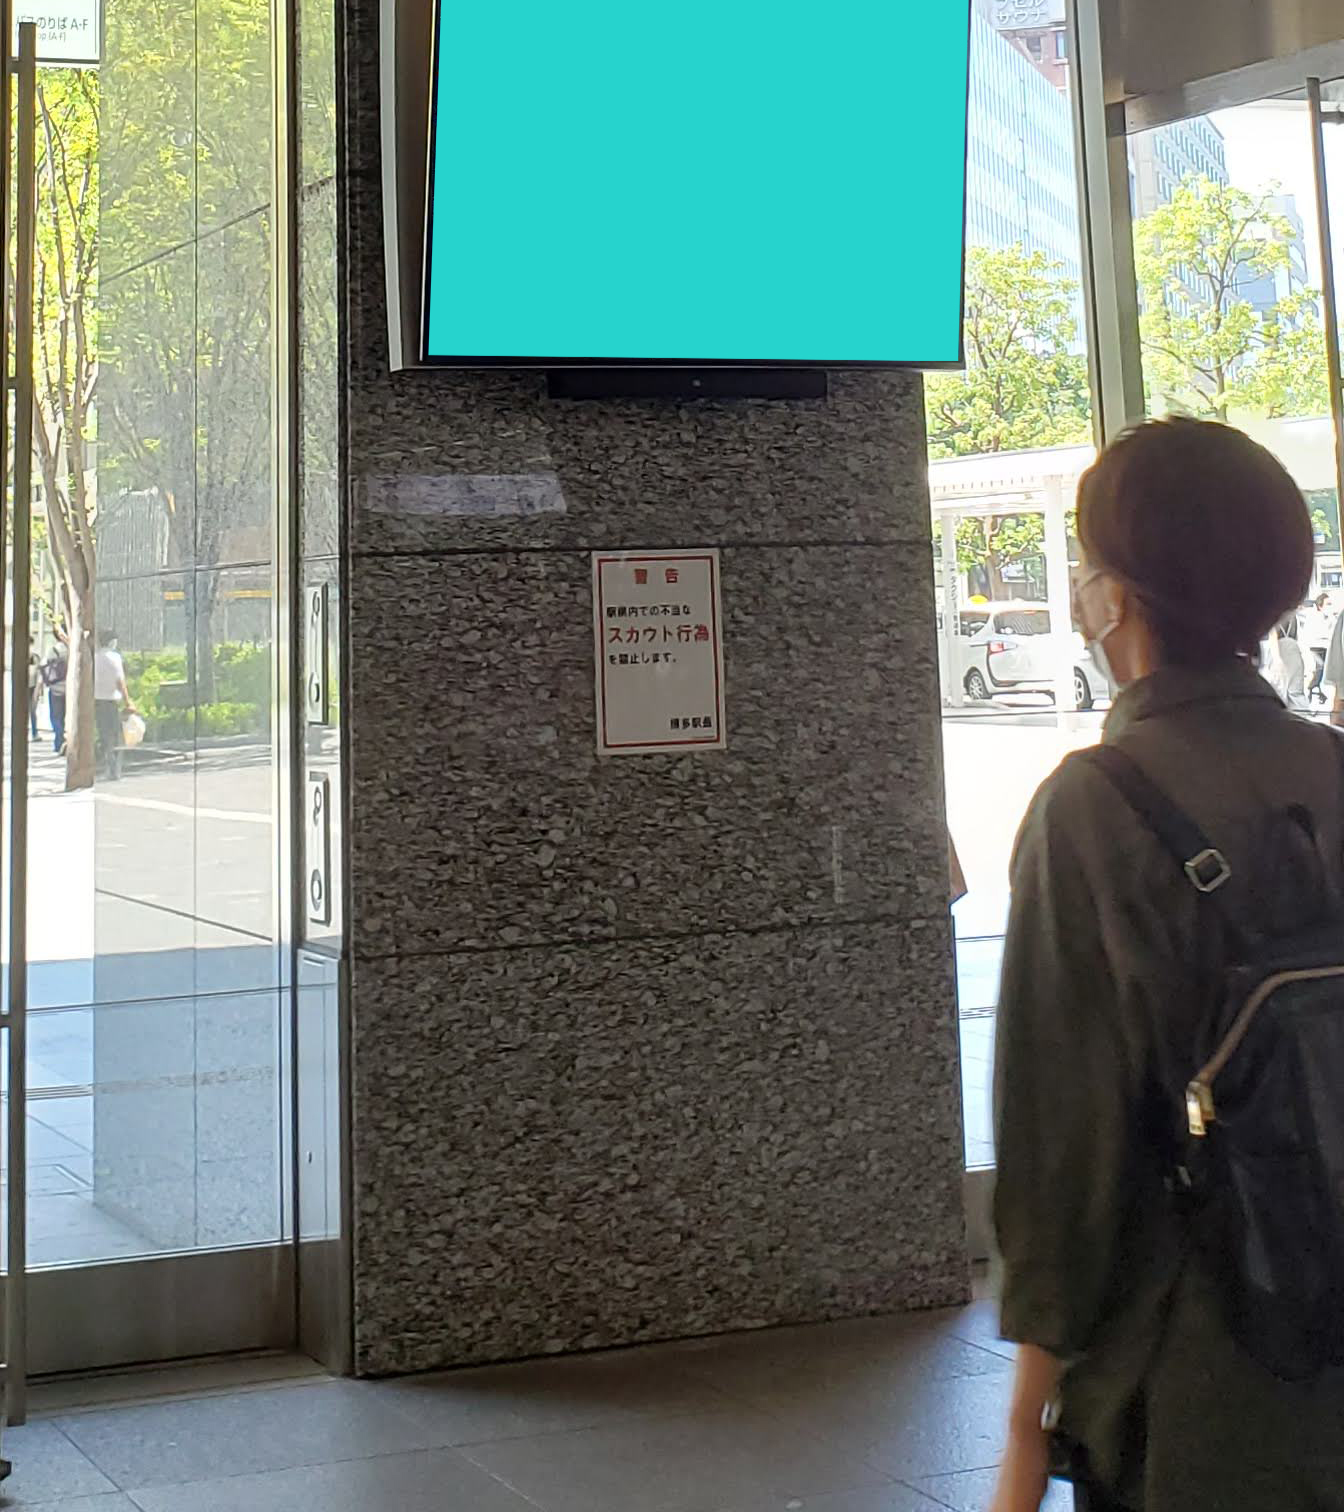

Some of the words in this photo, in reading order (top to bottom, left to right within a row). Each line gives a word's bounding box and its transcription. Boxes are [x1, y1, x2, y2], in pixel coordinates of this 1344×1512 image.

[995, 8, 1047, 25] サウナ
[608, 624, 710, 644] スカウト行為
